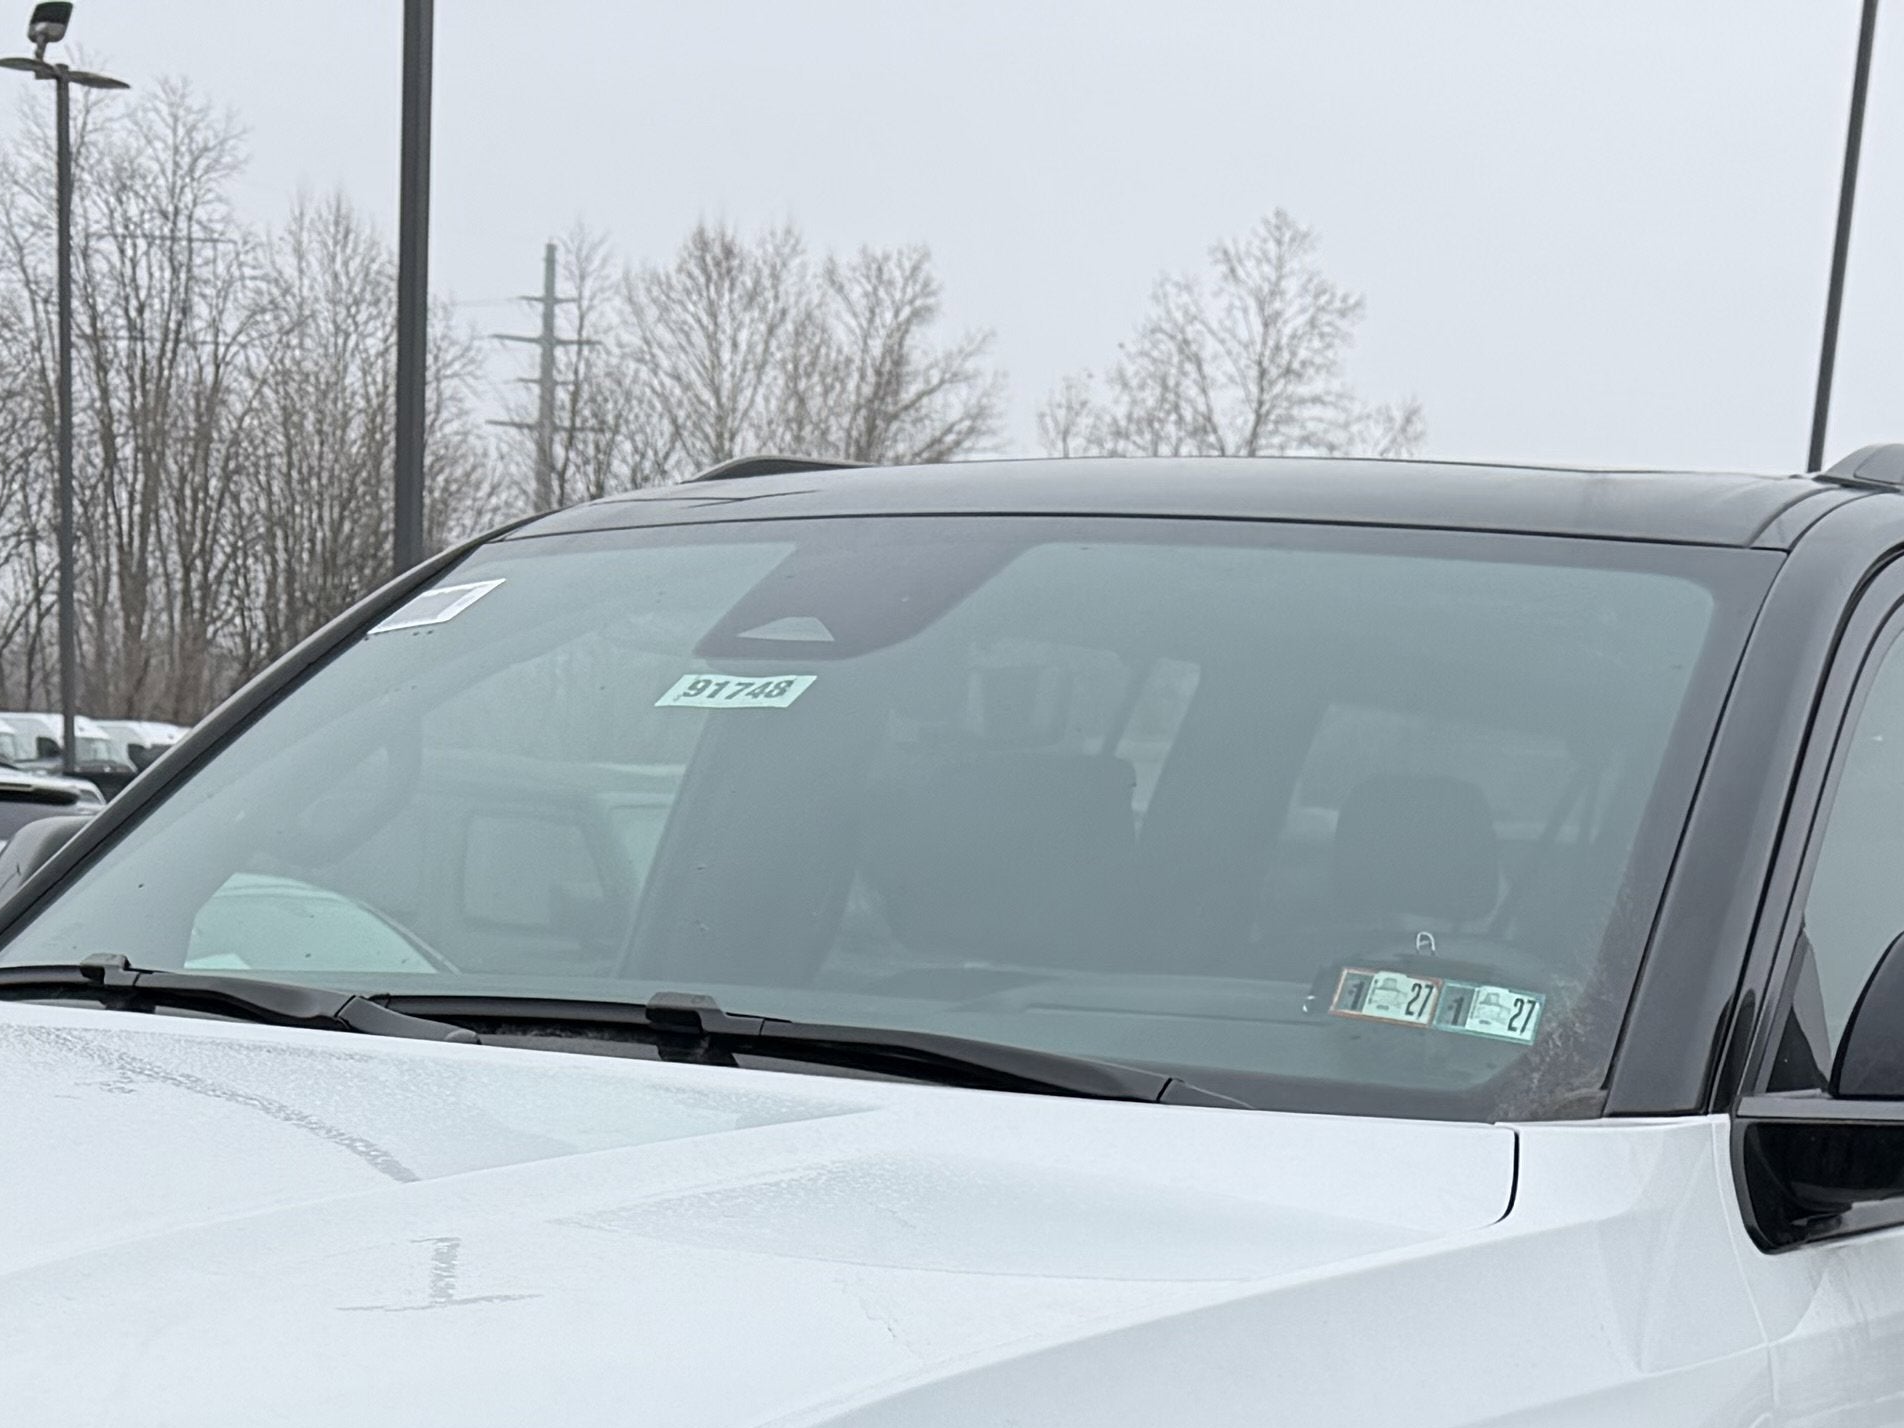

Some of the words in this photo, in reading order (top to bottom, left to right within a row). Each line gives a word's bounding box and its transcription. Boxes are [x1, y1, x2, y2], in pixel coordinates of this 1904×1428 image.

[683, 678, 793, 700] 91748
[1405, 983, 1434, 1018] 27
[1507, 998, 1536, 1034] 27
